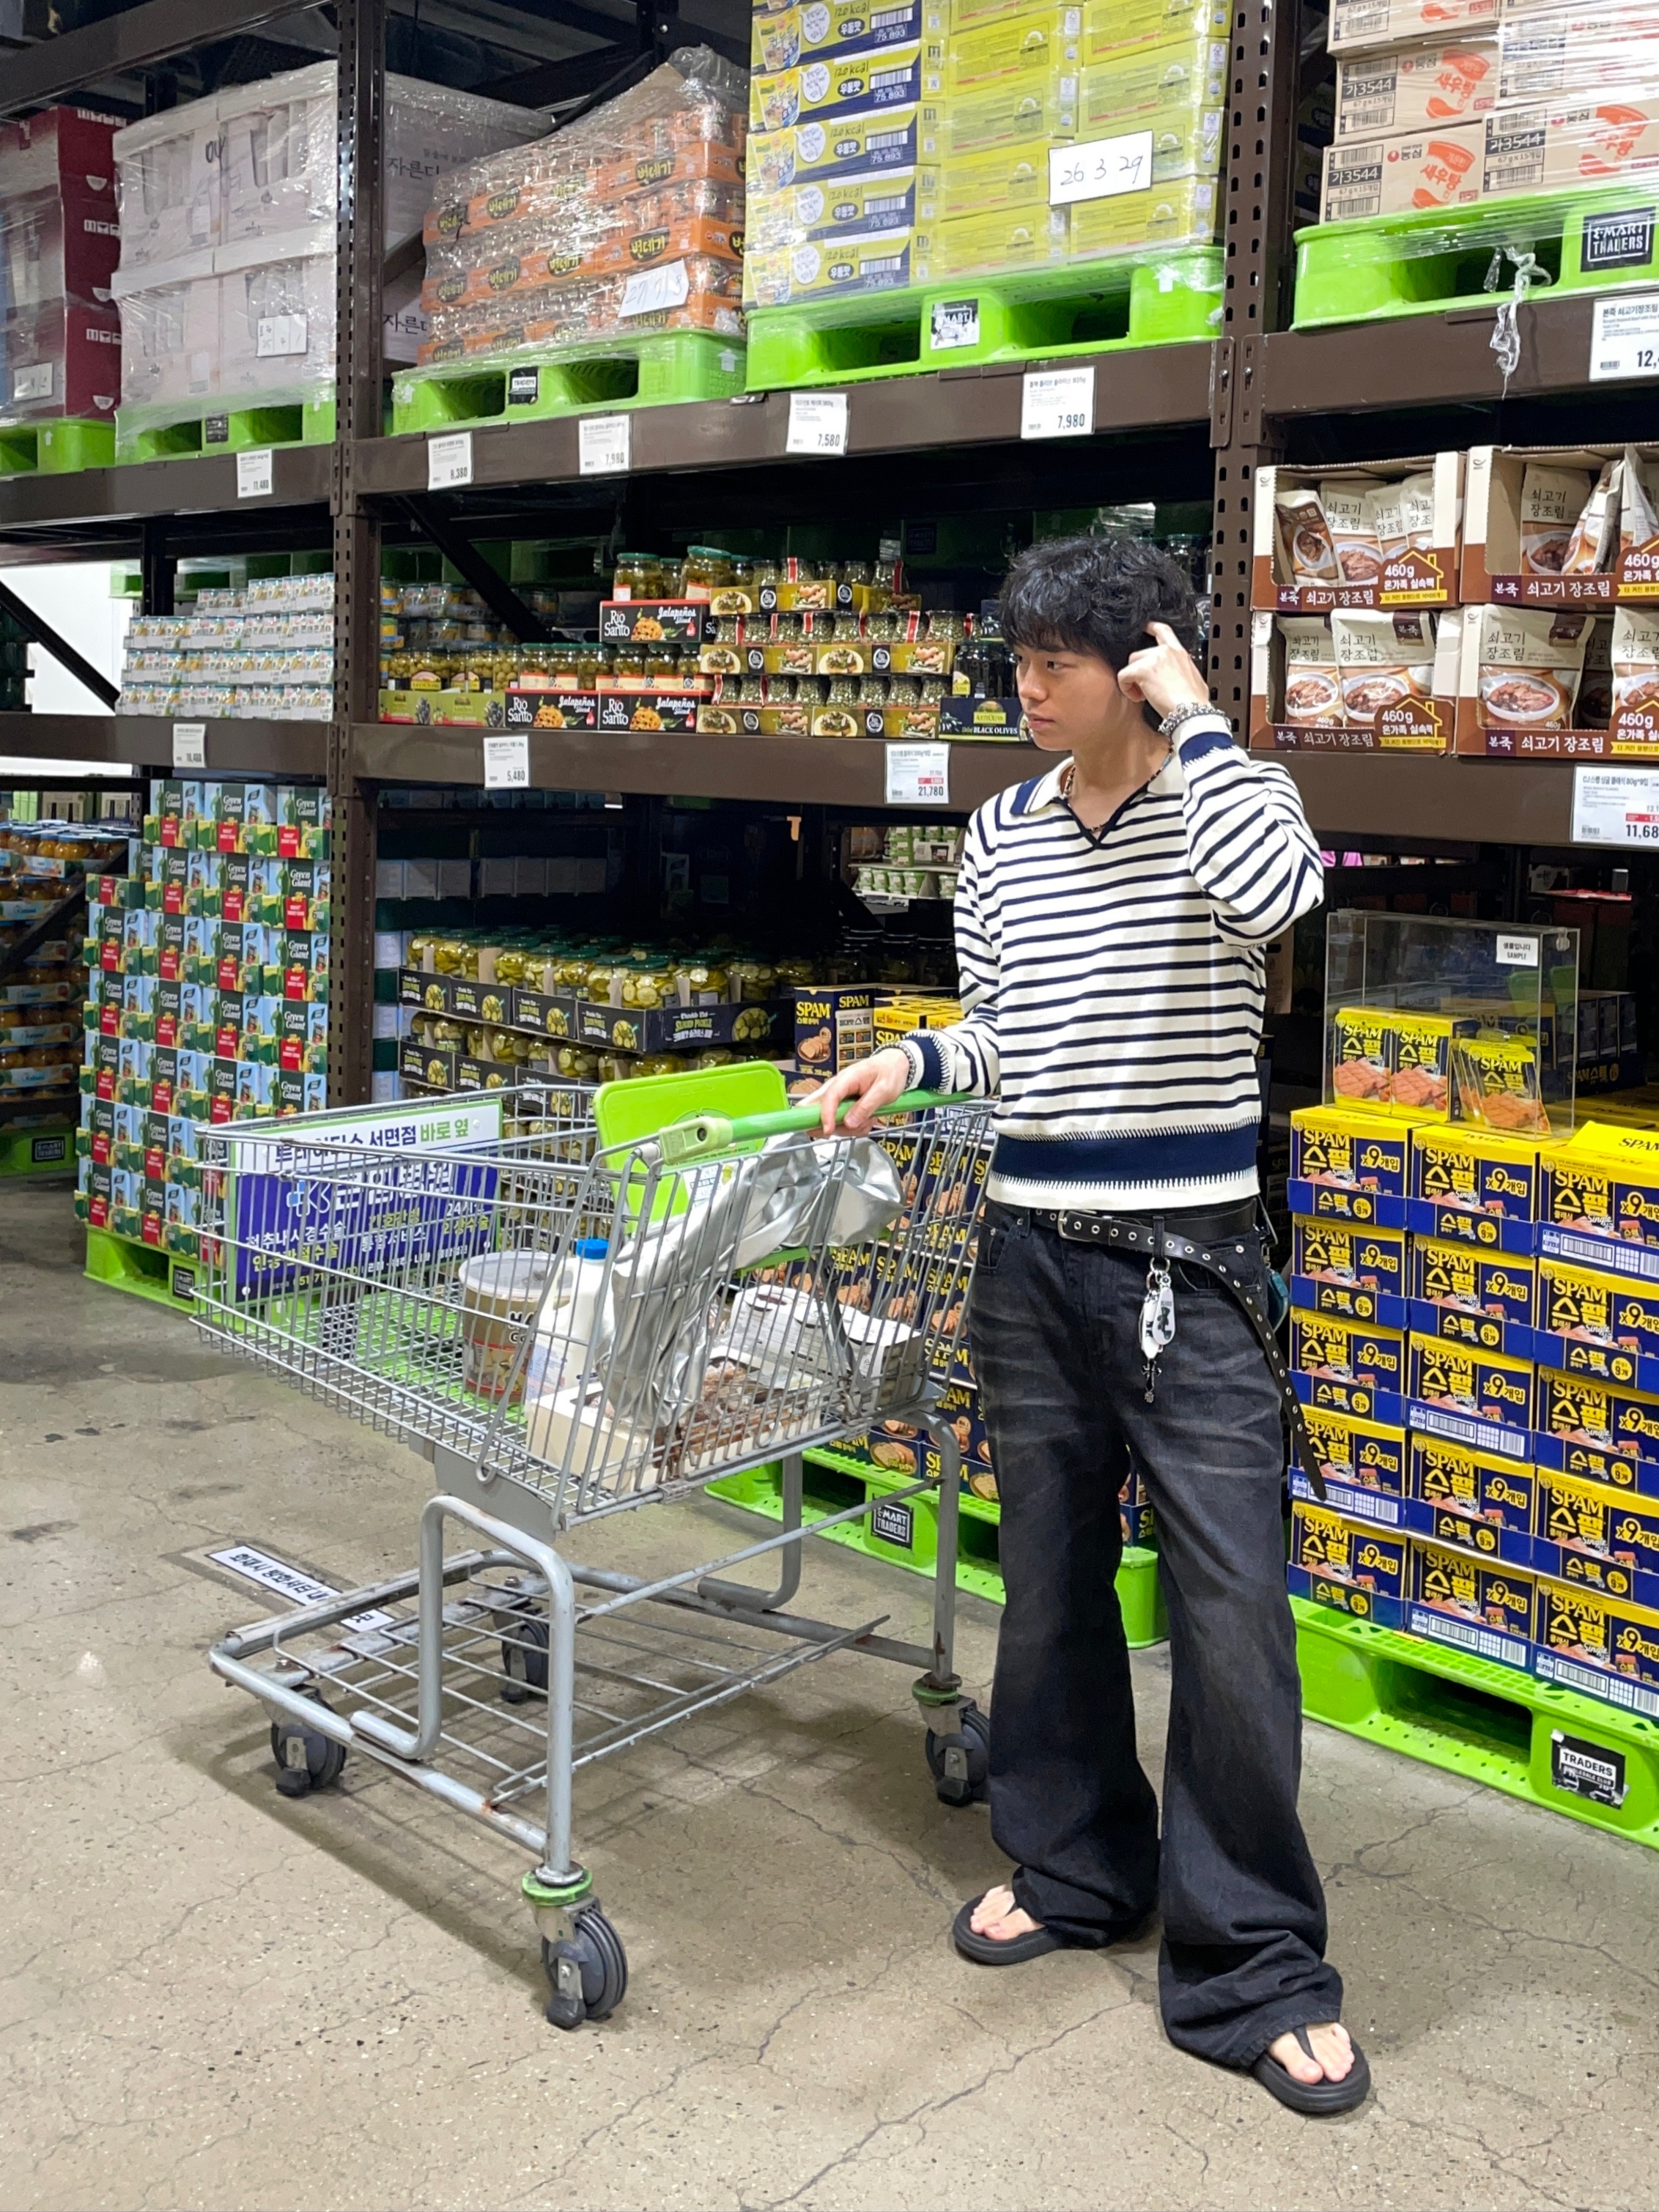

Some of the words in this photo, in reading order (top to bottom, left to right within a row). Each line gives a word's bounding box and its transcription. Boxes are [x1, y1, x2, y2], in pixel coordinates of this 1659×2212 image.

[840, 19, 862, 36] 우동맛
[840, 79, 861, 95] 우동맛
[1346, 78, 1392, 97] 가3544
[1435, 73, 1477, 98] 새우탕
[836, 140, 857, 156] 우동맛
[1490, 133, 1542, 152] 가3544
[638, 160, 672, 183] 번데기
[1060, 163, 1084, 185] 26
[1094, 158, 1106, 180] 3
[1120, 155, 1143, 184] 29
[1331, 167, 1378, 185] 가3544
[1420, 164, 1463, 192] 새우탕
[632, 235, 665, 259] 번데기
[1637, 350, 1659, 369] 12,
[1057, 413, 1085, 430] 7,980
[818, 434, 840, 447] 7,580
[605, 452, 624, 465] 7,980
[451, 467, 468, 480] 8,380
[1531, 504, 1565, 518] 장조림
[1624, 553, 1659, 569] 460g
[1384, 564, 1414, 578] 460g
[1623, 570, 1652, 582] 온가족
[1384, 580, 1408, 591] 온가족
[1495, 582, 1519, 596] 본죽
[1527, 581, 1565, 598] 쇠고기
[1570, 580, 1610, 598] 장조림
[1279, 591, 1299, 604] 본죽
[1307, 592, 1336, 605] 쇠고기
[1340, 590, 1374, 605] 장조림
[610, 610, 626, 624] Rio
[657, 607, 696, 620] Jalapeños
[605, 622, 629, 637] Santo
[1340, 634, 1375, 647] 쇠고기
[1488, 631, 1526, 645] 쇠고기
[1487, 647, 1525, 661] 장조림
[513, 697, 528, 710] Rio
[558, 695, 596, 709] Jalapeños
[609, 698, 624, 712] Rio
[656, 696, 695, 710] Jalapeños
[508, 709, 533, 722] Santo
[602, 709, 628, 725] Santo
[1382, 710, 1413, 723] 460g
[1619, 713, 1654, 729] 460g
[973, 726, 993, 734] BLACK
[1382, 725, 1408, 736] 온가족
[1617, 729, 1645, 741] 온가족
[1277, 733, 1297, 744] 본죽
[1304, 733, 1336, 746] 쇠고기
[1339, 733, 1374, 747] 장조림
[1489, 736, 1513, 751] 본죽
[1521, 736, 1559, 752] 쇠고기
[1564, 736, 1603, 754] 장조림
[507, 770, 525, 783] 5,480
[918, 786, 943, 797] 21,780
[1626, 824, 1659, 839] 11,68
[290, 870, 311, 879] Green
[291, 879, 311, 887] Giant
[105, 917, 122, 926] Green
[106, 925, 122, 934] Giant
[288, 940, 308, 951] Green
[289, 950, 309, 959] Giant
[839, 995, 869, 1008] SPAM
[284, 1010, 304, 1021] Green
[797, 1002, 831, 1018] SPAM
[285, 1021, 306, 1030] Giant
[1343, 1024, 1382, 1040] SPAM
[1400, 1029, 1438, 1047] SPAM
[1342, 1037, 1382, 1057] 스팸
[1399, 1043, 1437, 1065] 스팸
[1480, 1057, 1523, 1073] SPAM
[215, 1069, 234, 1079] Green
[1483, 1071, 1524, 1090] 스팸
[216, 1079, 234, 1089] Giant
[281, 1081, 301, 1092] Green
[281, 1091, 302, 1101] Giant
[369, 1125, 416, 1147] 서면점
[420, 1121, 451, 1142] 바로
[454, 1118, 469, 1138] 옆
[1304, 1128, 1351, 1150] SPAM
[1303, 1146, 1351, 1170] 스팸
[1425, 1148, 1476, 1172] SPAM
[1425, 1166, 1475, 1192] 스팸
[1554, 1169, 1608, 1194] SPAM
[1553, 1188, 1608, 1217] 스팸
[1304, 1225, 1351, 1247] SPAM
[1304, 1242, 1351, 1268] 스팸
[1426, 1249, 1475, 1274] SPAM
[1426, 1267, 1475, 1295] 스팸
[1455, 1292, 1478, 1303] Single
[1553, 1278, 1608, 1304] SPAM
[1551, 1297, 1608, 1325] 스팸
[1301, 1323, 1348, 1345] SPAM
[1585, 1323, 1610, 1334] Single
[1301, 1339, 1348, 1366] 스팸
[1423, 1350, 1473, 1375] SPAM
[1422, 1367, 1473, 1395] 스팸
[1552, 1380, 1608, 1408] SPAM
[1551, 1400, 1607, 1429] 스팸
[1304, 1418, 1349, 1444] SPAM
[1425, 1451, 1474, 1478] SPAM
[1425, 1469, 1474, 1498] 스팸
[1551, 1488, 1604, 1517] SPAM
[876, 1517, 906, 1537] TRADERS
[1304, 1517, 1348, 1542] SPAM
[1550, 1507, 1604, 1539] 스팸
[1303, 1535, 1348, 1564] 스팸
[1425, 1552, 1475, 1580] SPAM
[1425, 1569, 1476, 1600] 스팸
[1551, 1594, 1606, 1625] SPAM
[1550, 1614, 1606, 1647] 스팸
[1563, 1752, 1612, 1776] TRADERS
[1597, 1777, 1611, 1785] CLUB
